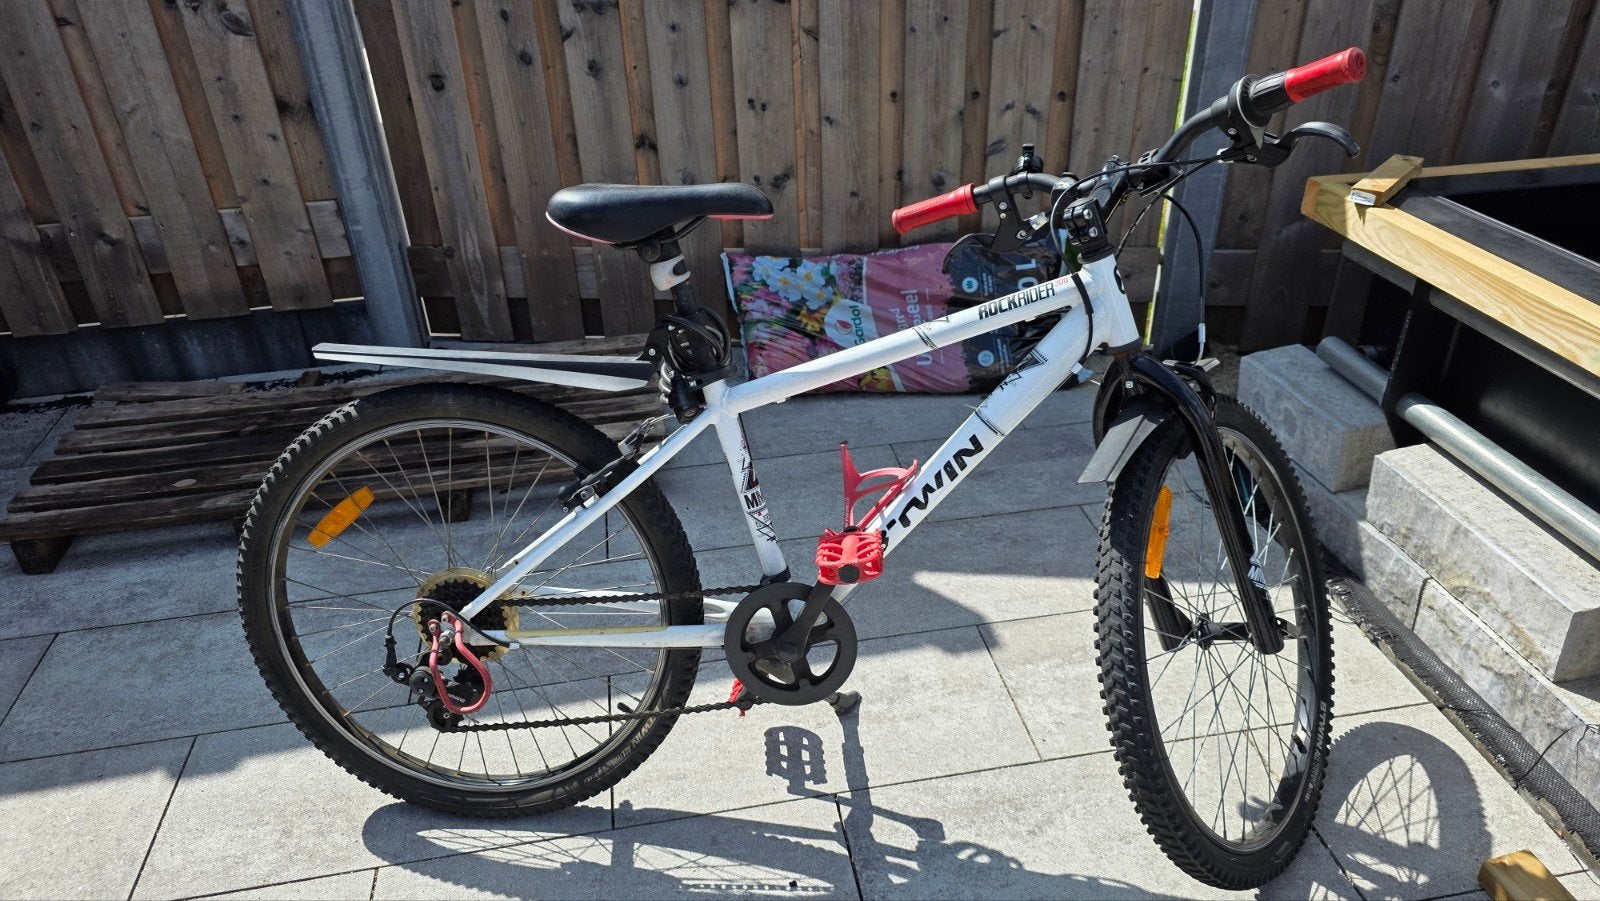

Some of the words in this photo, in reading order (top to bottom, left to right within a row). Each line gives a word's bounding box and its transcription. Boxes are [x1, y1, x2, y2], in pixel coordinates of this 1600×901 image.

[978, 283, 1056, 320] ROCKRIDER
[848, 304, 866, 346] Gardol
[631, 716, 657, 748] TWIN
[1317, 702, 1327, 750] BTWIN
